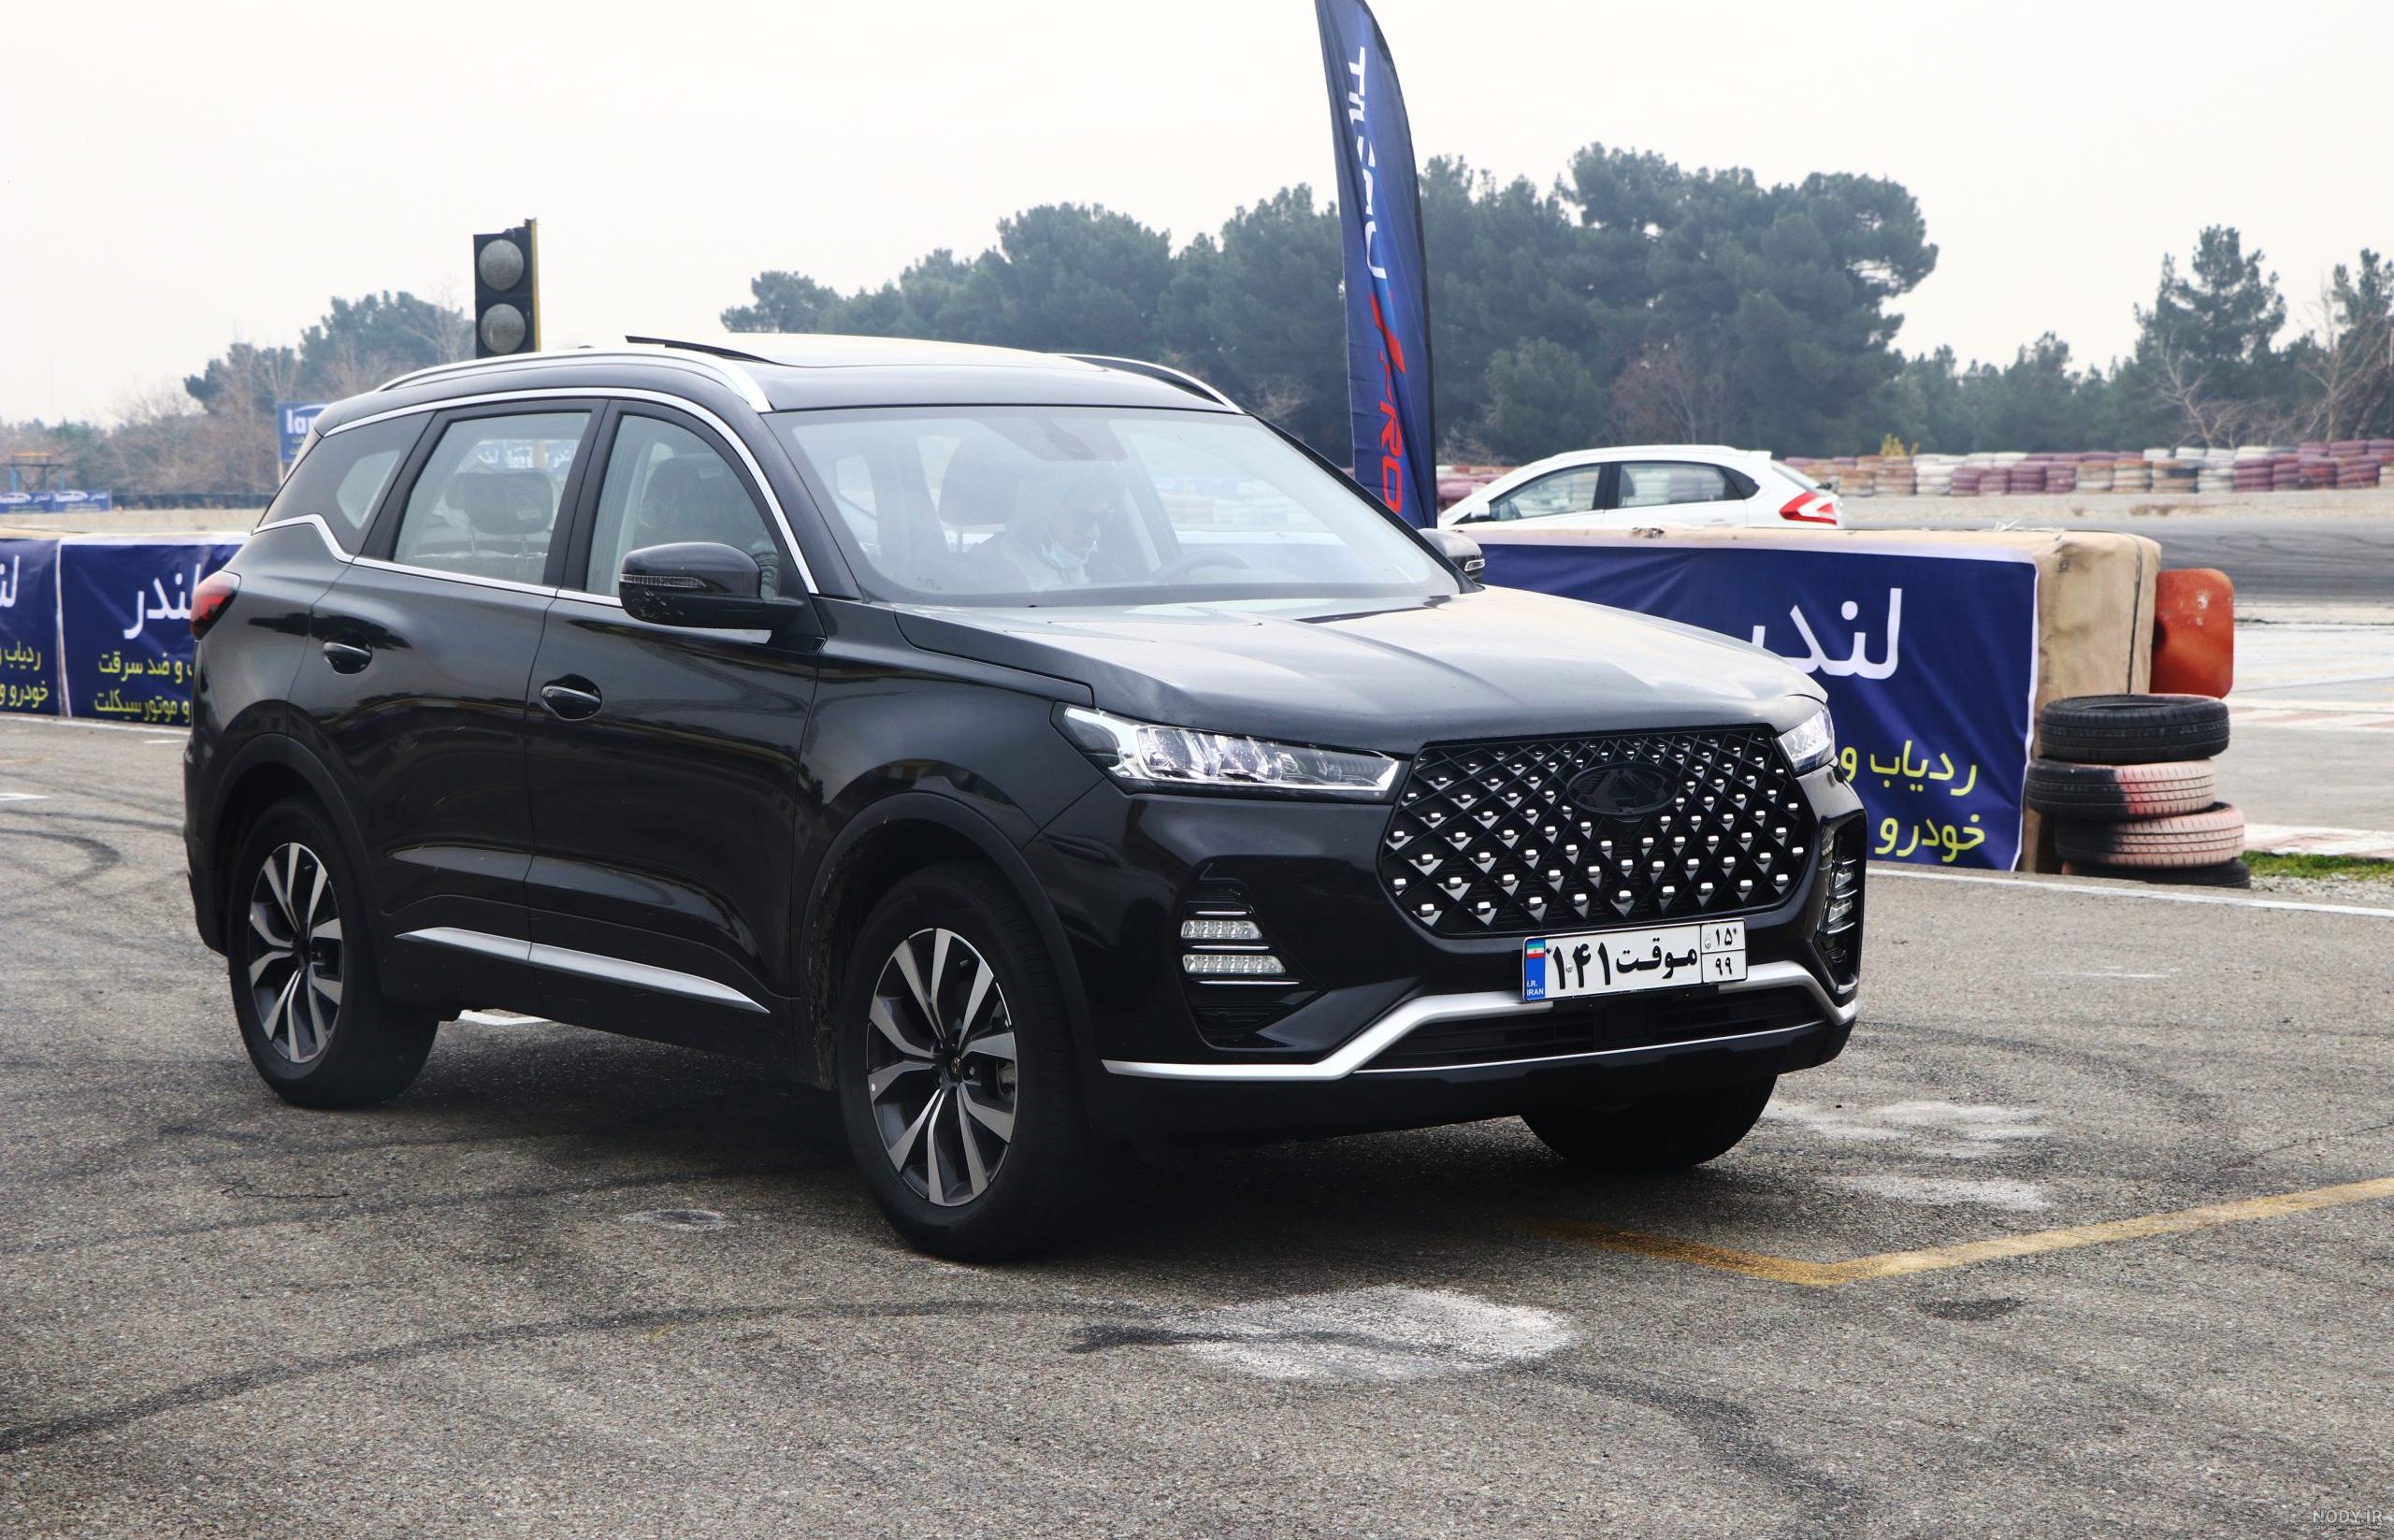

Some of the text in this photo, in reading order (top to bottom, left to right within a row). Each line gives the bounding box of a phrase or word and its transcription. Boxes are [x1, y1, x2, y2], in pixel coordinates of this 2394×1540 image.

[5, 640, 41, 671] ردیاب
[97, 651, 143, 682] سرقت
[147, 651, 170, 675] ضد
[8, 680, 49, 709] خودرو
[1840, 741, 1977, 796] ردیاب و
[1875, 813, 1985, 862] خودرو
[1552, 936, 1697, 989] ۱۴۱ موقت
[1715, 957, 1733, 976] ۹۹
[1526, 987, 1544, 996] IRAN
